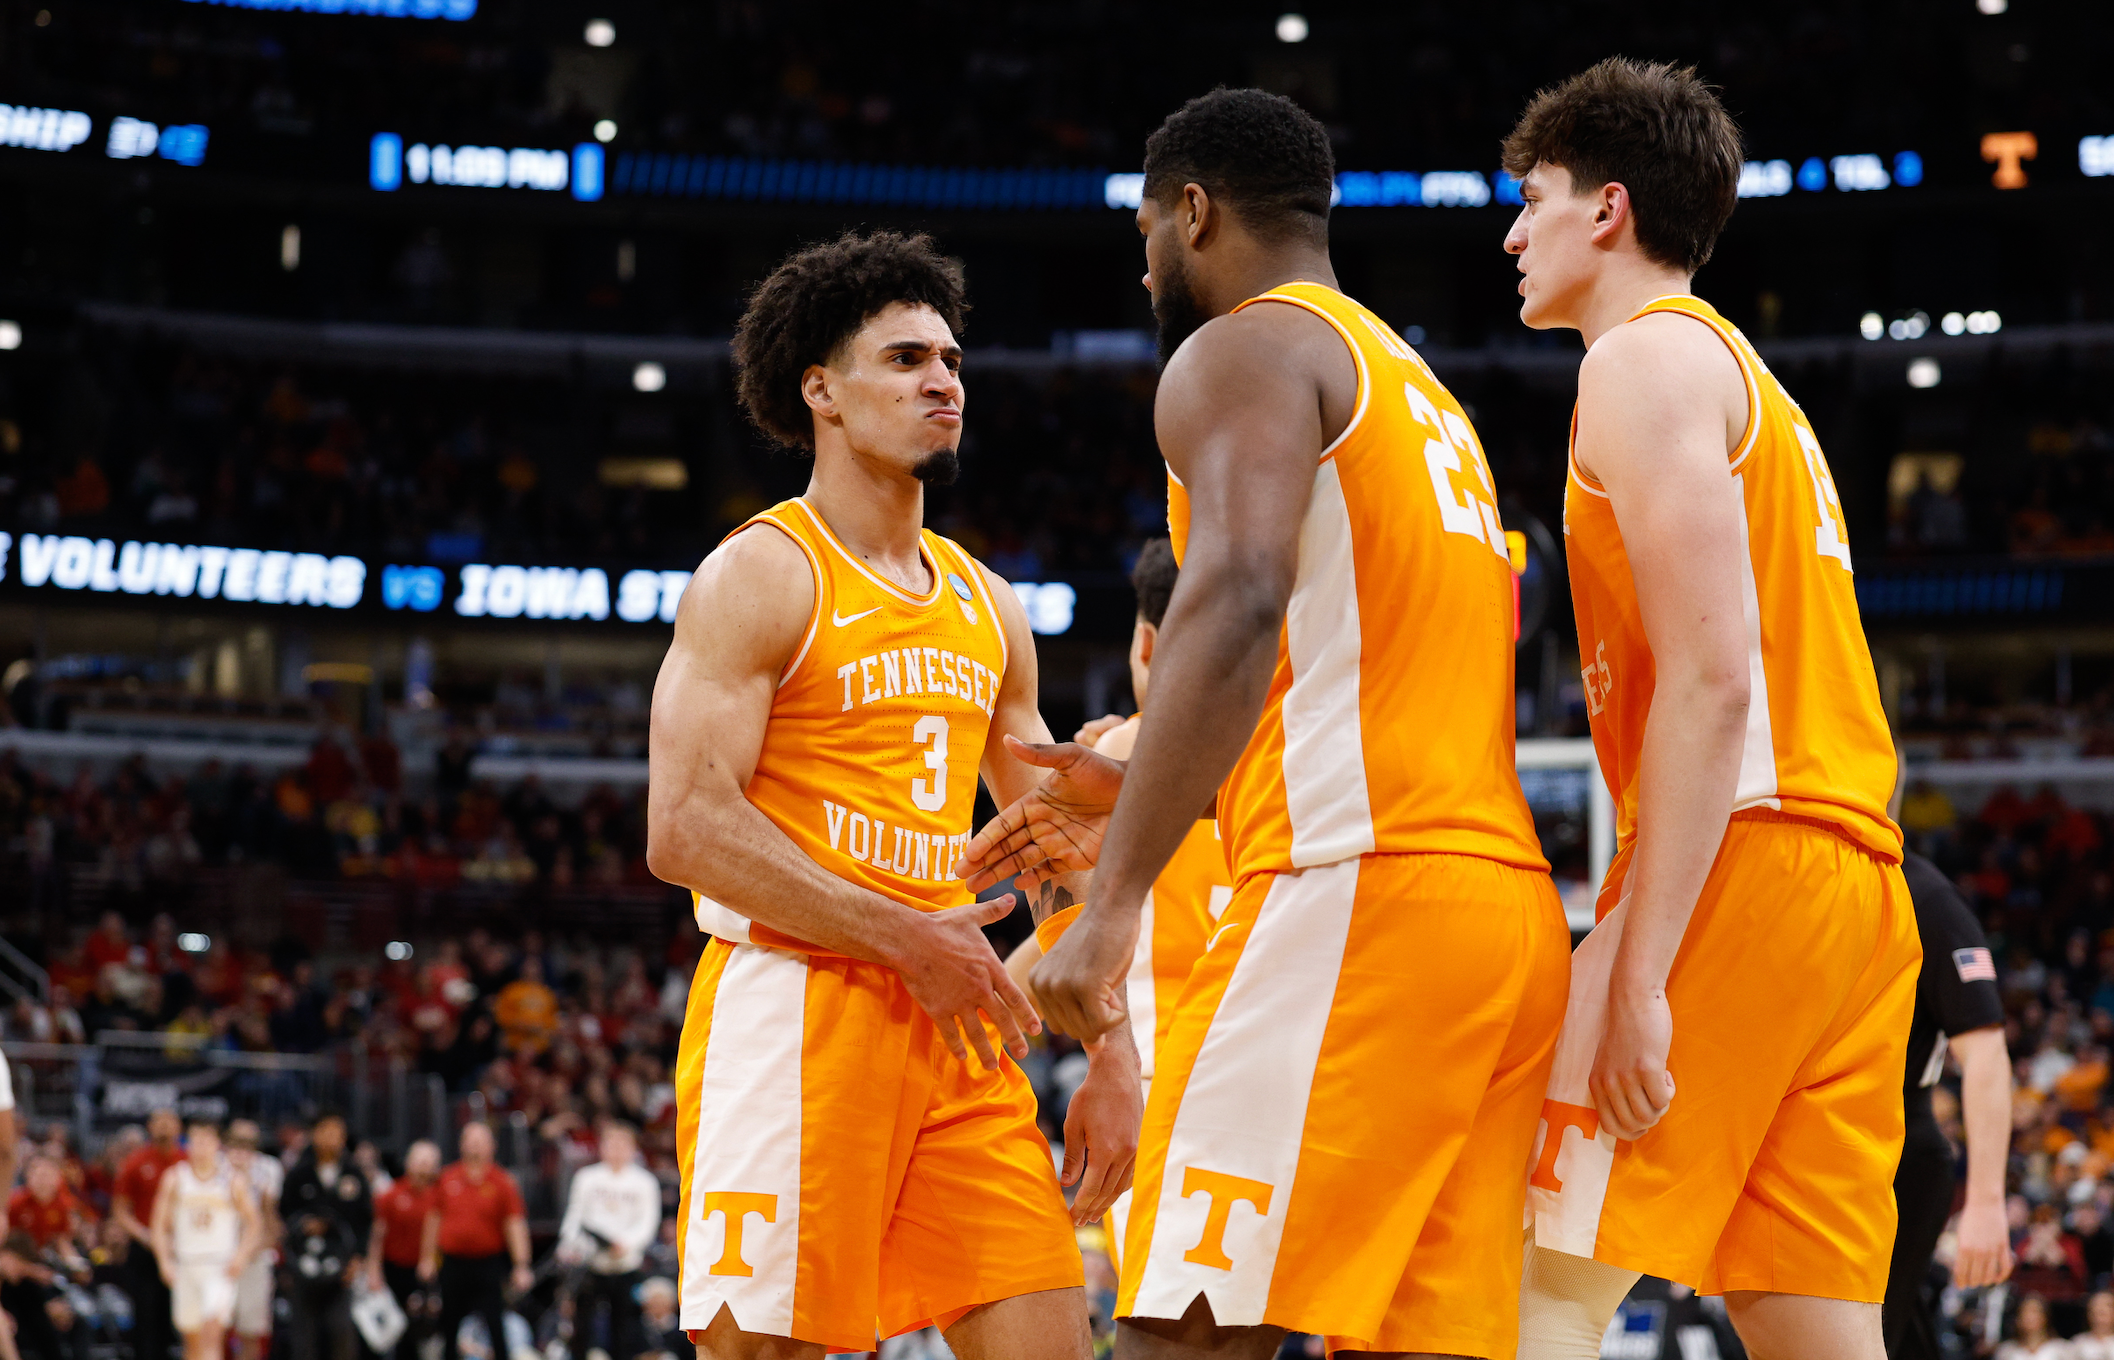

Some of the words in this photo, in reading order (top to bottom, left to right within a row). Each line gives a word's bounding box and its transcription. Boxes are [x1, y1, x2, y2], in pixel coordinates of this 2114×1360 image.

[1980, 131, 2038, 190] T
[20, 533, 366, 608] VOLUNTEERS
[382, 564, 443, 611] VS
[456, 563, 609, 620] IOWA
[837, 647, 999, 721] TENNESSEE
[911, 715, 950, 812] 3
[702, 1191, 778, 1278] T
[1181, 1166, 1274, 1272] T
